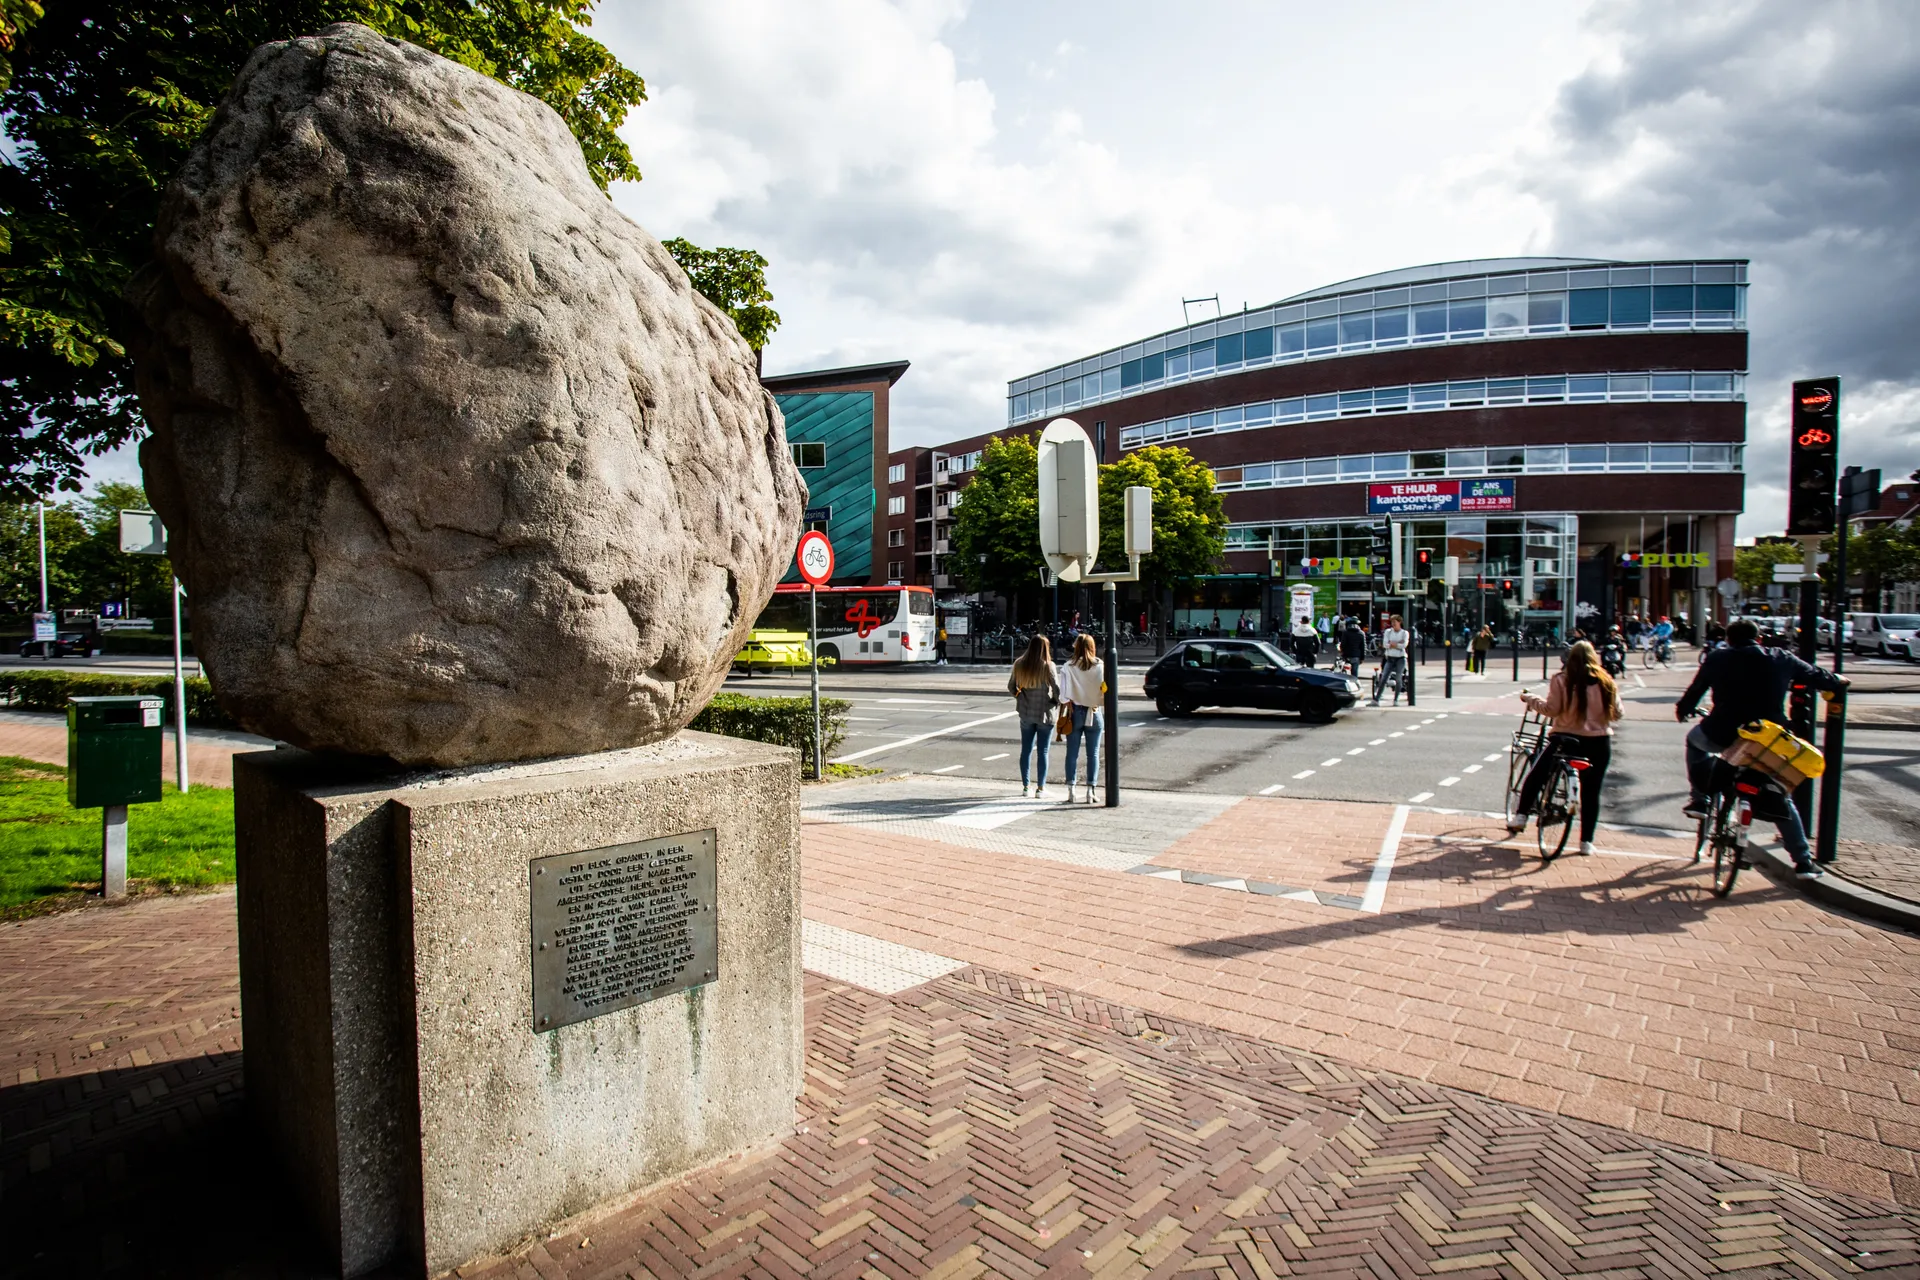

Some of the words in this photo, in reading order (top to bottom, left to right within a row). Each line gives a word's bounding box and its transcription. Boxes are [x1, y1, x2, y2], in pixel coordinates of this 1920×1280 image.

[1376, 494, 1452, 504] kantooretage
[1391, 486, 1404, 494] TE
[1406, 484, 1438, 494] HUUR
[1323, 557, 1386, 575] PLU
[1642, 552, 1710, 568] PLUS
[570, 863, 583, 873] DIT
[588, 858, 611, 869] BLOK
[668, 845, 683, 854] EEN
[597, 867, 621, 878] DOOR
[627, 863, 643, 872] EEN
[649, 853, 692, 868] GLETSCHER
[556, 885, 625, 906] AMERSFOORTSE
[630, 880, 654, 891] HEIDE
[569, 884, 584, 894] UIT
[648, 867, 669, 878] NAAR
[675, 864, 685, 872] DE
[568, 904, 580, 914] EN
[584, 902, 593, 910] IN
[621, 888, 660, 902] GENOEMD
[662, 886, 670, 894] IN
[672, 882, 687, 891] EEN
[569, 906, 623, 924] STAATSSTUK
[628, 901, 644, 911] VAN
[650, 894, 675, 906] KAREL
[554, 924, 581, 937] WERD
[585, 921, 593, 930] IN
[618, 910, 645, 923] ONDER
[649, 902, 678, 915] LEIDING
[684, 898, 698, 908] VAN
[613, 921, 637, 933] DOOR
[644, 907, 698, 926] VIERHONDERD
[567, 951, 591, 964] NAAR
[597, 947, 609, 956] DE
[613, 931, 674, 952] VARKENSMARKT
[569, 937, 609, 953] BURGERS
[614, 932, 630, 942] VAN
[637, 918, 687, 937] AMERSFOORT
[589, 969, 597, 977] IN
[624, 948, 676, 968] OPGEDOLVEN
[680, 945, 690, 953] EN
[605, 952, 626, 964] DAAR
[630, 949, 638, 957] IN
[562, 985, 575, 994] NA
[578, 978, 601, 990] VELE
[605, 960, 668, 983] OMZWERVINGEN
[673, 953, 694, 964] DOOR
[574, 988, 598, 1001] ONZE
[602, 981, 623, 993] STAD
[625, 979, 633, 987] IN
[658, 969, 669, 978] OP
[673, 964, 684, 974] DIT
[584, 989, 627, 1008] VOETSTUK
[632, 976, 674, 994] GEPLAATST
